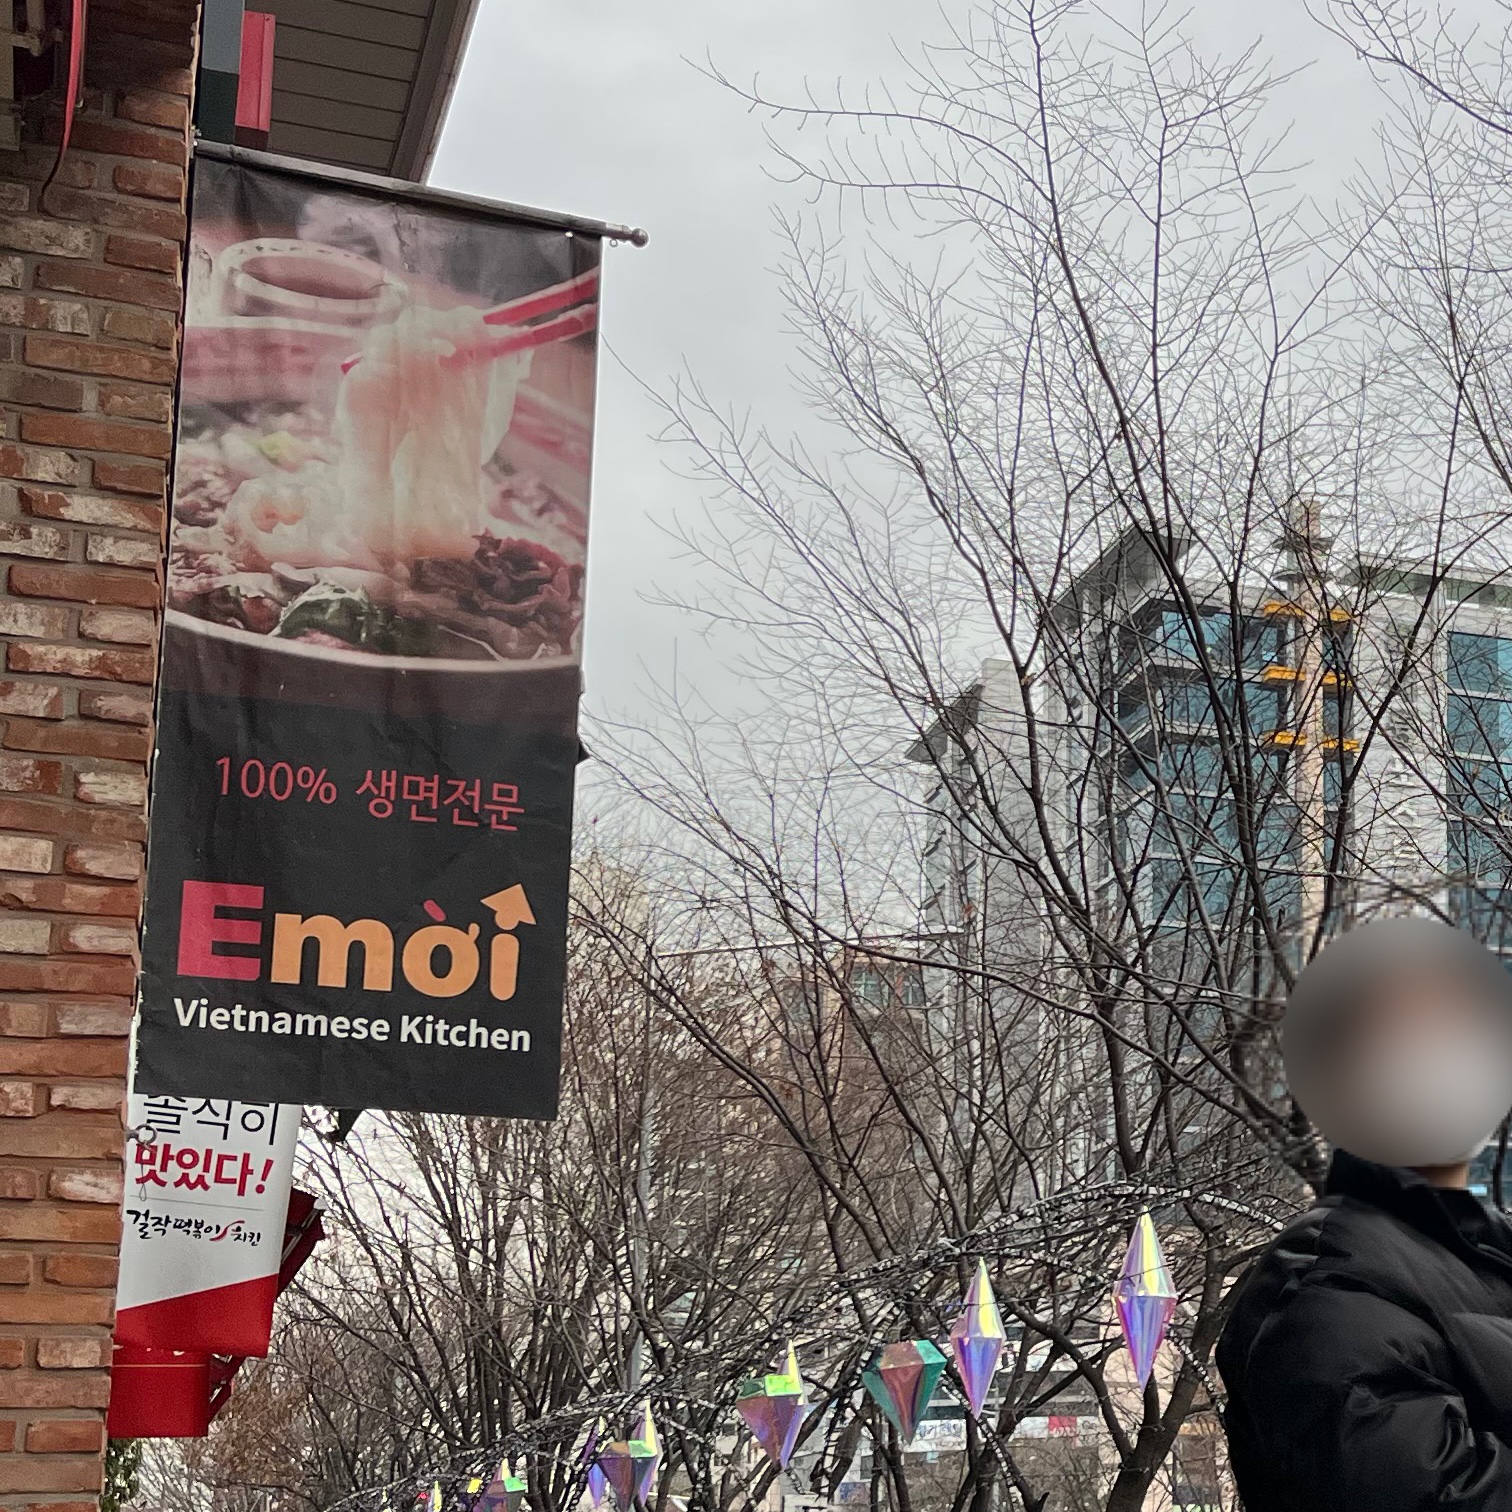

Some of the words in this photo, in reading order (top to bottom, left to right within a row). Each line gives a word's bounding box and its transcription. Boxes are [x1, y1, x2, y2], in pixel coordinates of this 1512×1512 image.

[215, 756, 338, 804] 100%
[356, 769, 525, 832] 생면전문
[173, 997, 391, 1042] Vietnamese
[399, 1014, 532, 1052] Kitchen
[134, 1143, 275, 1197] 맛있다!
[126, 1209, 221, 1240] 걸작떡볶이
